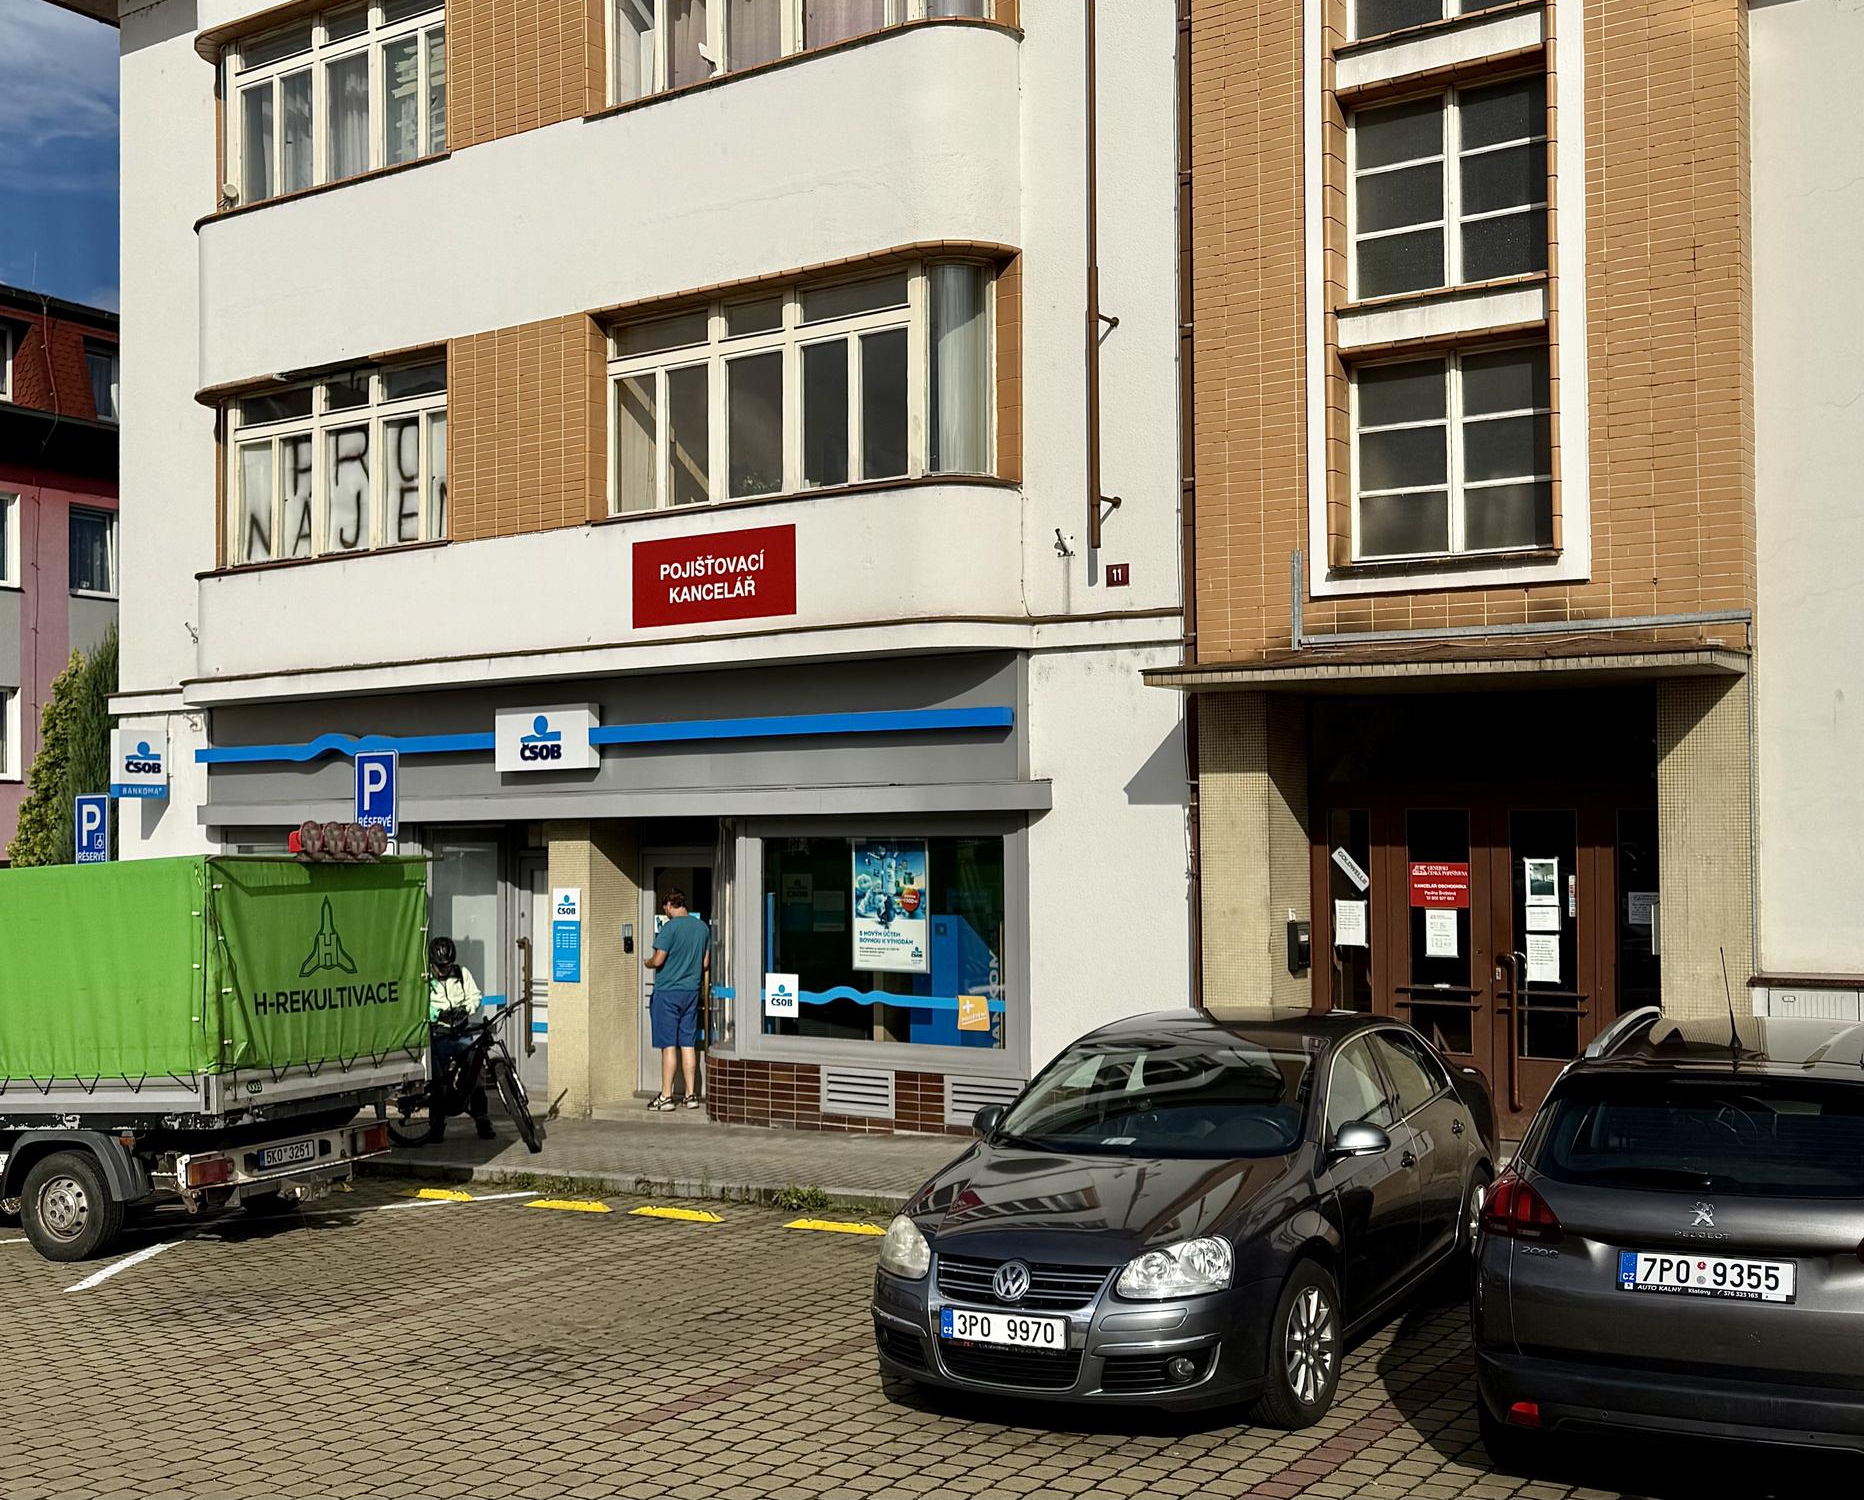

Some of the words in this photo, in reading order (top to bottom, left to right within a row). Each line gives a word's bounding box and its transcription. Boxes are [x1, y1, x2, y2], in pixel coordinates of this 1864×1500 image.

[660, 549, 764, 580] POJIŠŤOVACÍ
[1112, 568, 1122, 581] 11
[669, 575, 755, 603] KANCELÁŘ
[520, 743, 562, 761] ČSOB
[125, 760, 161, 773] ČSOB
[363, 762, 387, 810] P
[82, 804, 101, 847] P
[254, 981, 399, 1016] H-REKULTIVACE
[771, 997, 793, 1007] ČSOB
[289, 1143, 310, 1159] 3251
[1623, 1272, 1635, 1280] CZ
[1643, 1257, 1691, 1284] 7P0
[1712, 1262, 1780, 1291] 9355
[943, 1326, 953, 1335] CZ
[957, 1314, 991, 1338] 3P0
[1007, 1319, 1055, 1344] 9970
